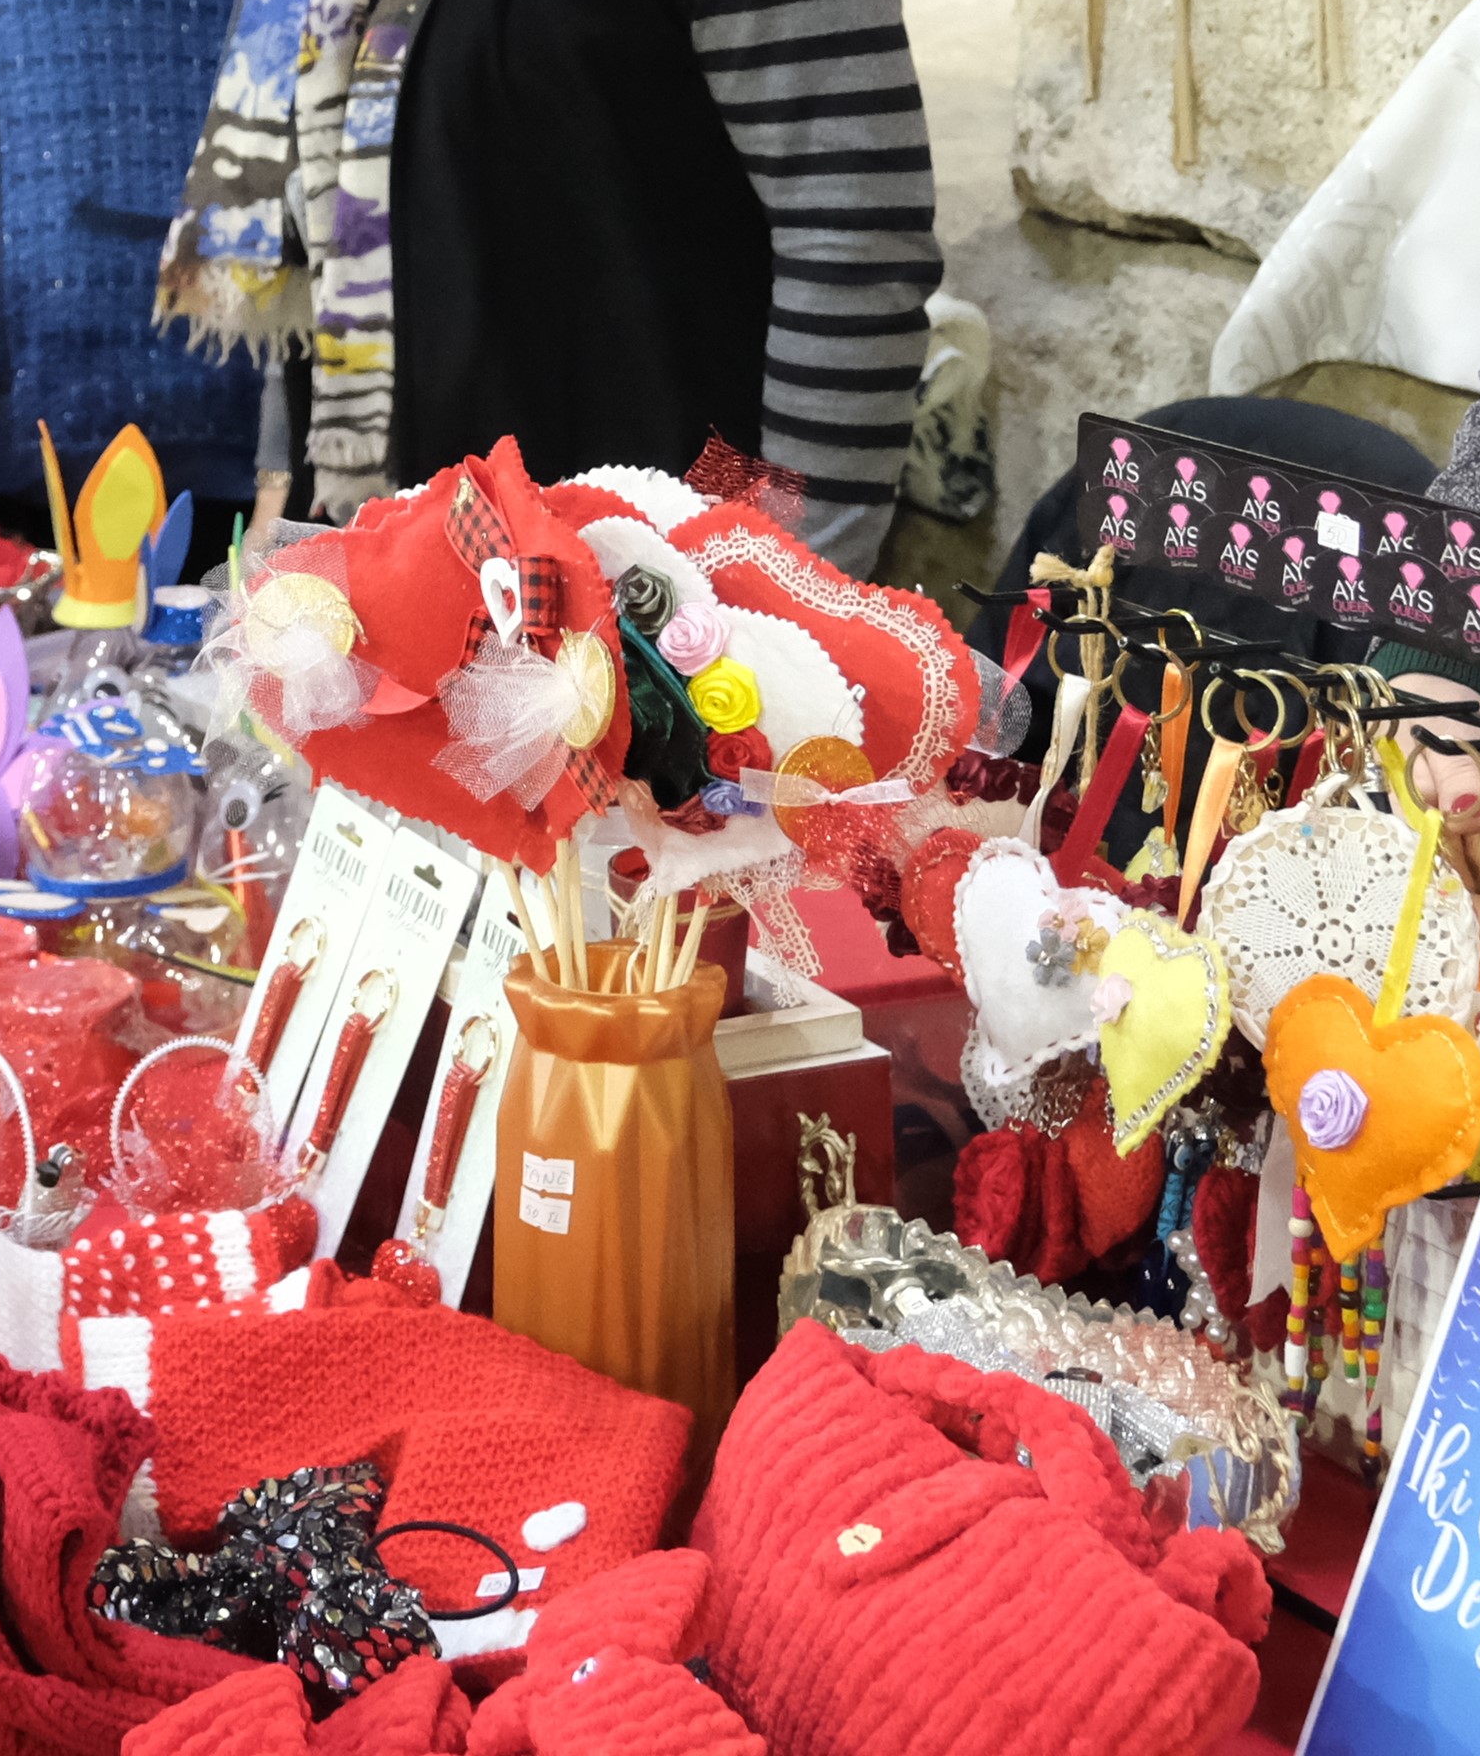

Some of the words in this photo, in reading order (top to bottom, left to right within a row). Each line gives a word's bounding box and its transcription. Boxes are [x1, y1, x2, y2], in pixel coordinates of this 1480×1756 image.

[1103, 457, 1139, 483] AYS
[1170, 480, 1207, 502] AYS
[1241, 498, 1281, 522] AYS
[1100, 514, 1137, 541] AYS
[1220, 542, 1259, 571] AYS
[1390, 583, 1434, 614] AYS
[1389, 602, 1434, 625] QUEEN
[1406, 1407, 1473, 1520] İki
